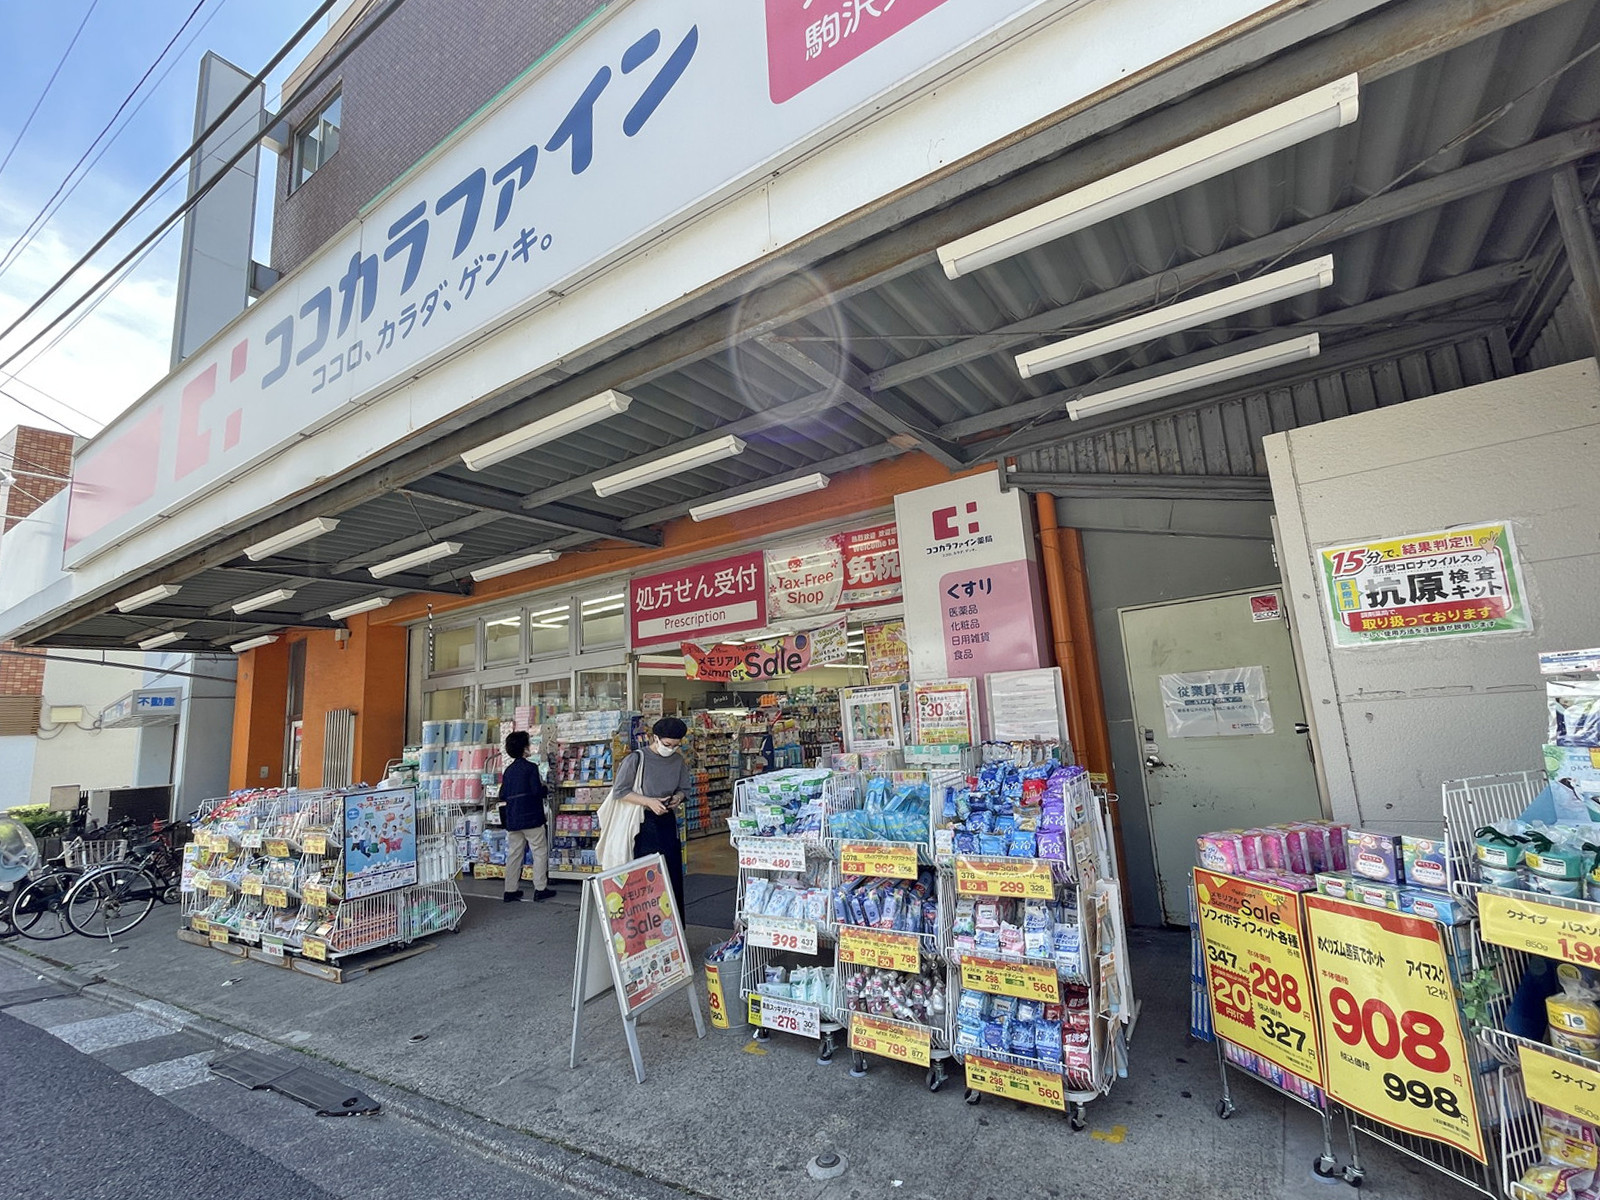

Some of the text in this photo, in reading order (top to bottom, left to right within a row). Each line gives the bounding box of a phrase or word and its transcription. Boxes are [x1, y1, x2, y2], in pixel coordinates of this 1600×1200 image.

[805, 0, 896, 61] 駒沢
[261, 24, 698, 390] ココカラファイン
[311, 226, 553, 394] ココロ、カラダ、ゲンキ。
[926, 535, 993, 555] ココカラファイン薬局
[846, 550, 900, 585] 免税
[1373, 554, 1483, 575] 新型コロナウイルスの
[777, 571, 834, 590] Tax-Free
[1450, 566, 1497, 585] 検査
[636, 563, 757, 612] 処方せん受付
[947, 577, 992, 599] くすり
[1366, 571, 1448, 609] 抗原
[1452, 581, 1502, 599] キット
[787, 590, 824, 605] Shop
[664, 610, 726, 629] Prescription
[949, 604, 979, 618] 医薬品
[1254, 610, 1280, 620] SECOM
[1361, 605, 1493, 630] 取り扱っております
[951, 618, 980, 632] 化粧品
[952, 631, 990, 647] 日用雑貨
[698, 656, 742, 667] メモリアル
[954, 648, 974, 661] 食品
[700, 650, 802, 678] Summer Sale
[1177, 681, 1246, 698] 従業員専用
[138, 696, 176, 707] 不動産
[772, 859, 790, 868] 480
[874, 863, 895, 873] 962
[1000, 864, 1018, 872] Sale
[621, 885, 655, 903] メモリアル
[1000, 881, 1025, 893] 299
[1030, 884, 1045, 892] 328
[1210, 891, 1240, 905] メモリアル
[618, 896, 661, 919] Summer
[1211, 898, 1281, 925] Summer Sale
[625, 913, 662, 939] Sale
[1201, 906, 1300, 949] ソフィボディフィット各種
[1506, 909, 1600, 936] クナイプ バスソ
[772, 934, 798, 949] 398
[801, 938, 814, 947] 437
[860, 947, 876, 958] 973
[901, 953, 917, 964] 798
[1207, 945, 1237, 968] 347
[1005, 963, 1024, 972] Sale
[1405, 959, 1446, 984] アイマスク
[985, 974, 999, 984] 298
[1321, 969, 1350, 986] 本体価格
[1033, 981, 1055, 994] 560
[1214, 976, 1251, 1013] 20
[1249, 961, 1302, 1014] 298
[777, 1014, 797, 1030] 278
[1329, 987, 1452, 1074] 908
[1260, 1014, 1306, 1052] 327
[886, 1041, 907, 1057] 798
[1010, 1065, 1029, 1077] Sale
[989, 1076, 1003, 1087] 298
[1551, 1069, 1597, 1092] クナイプ
[1038, 1087, 1060, 1100] 560
[1383, 1072, 1462, 1119] 998
